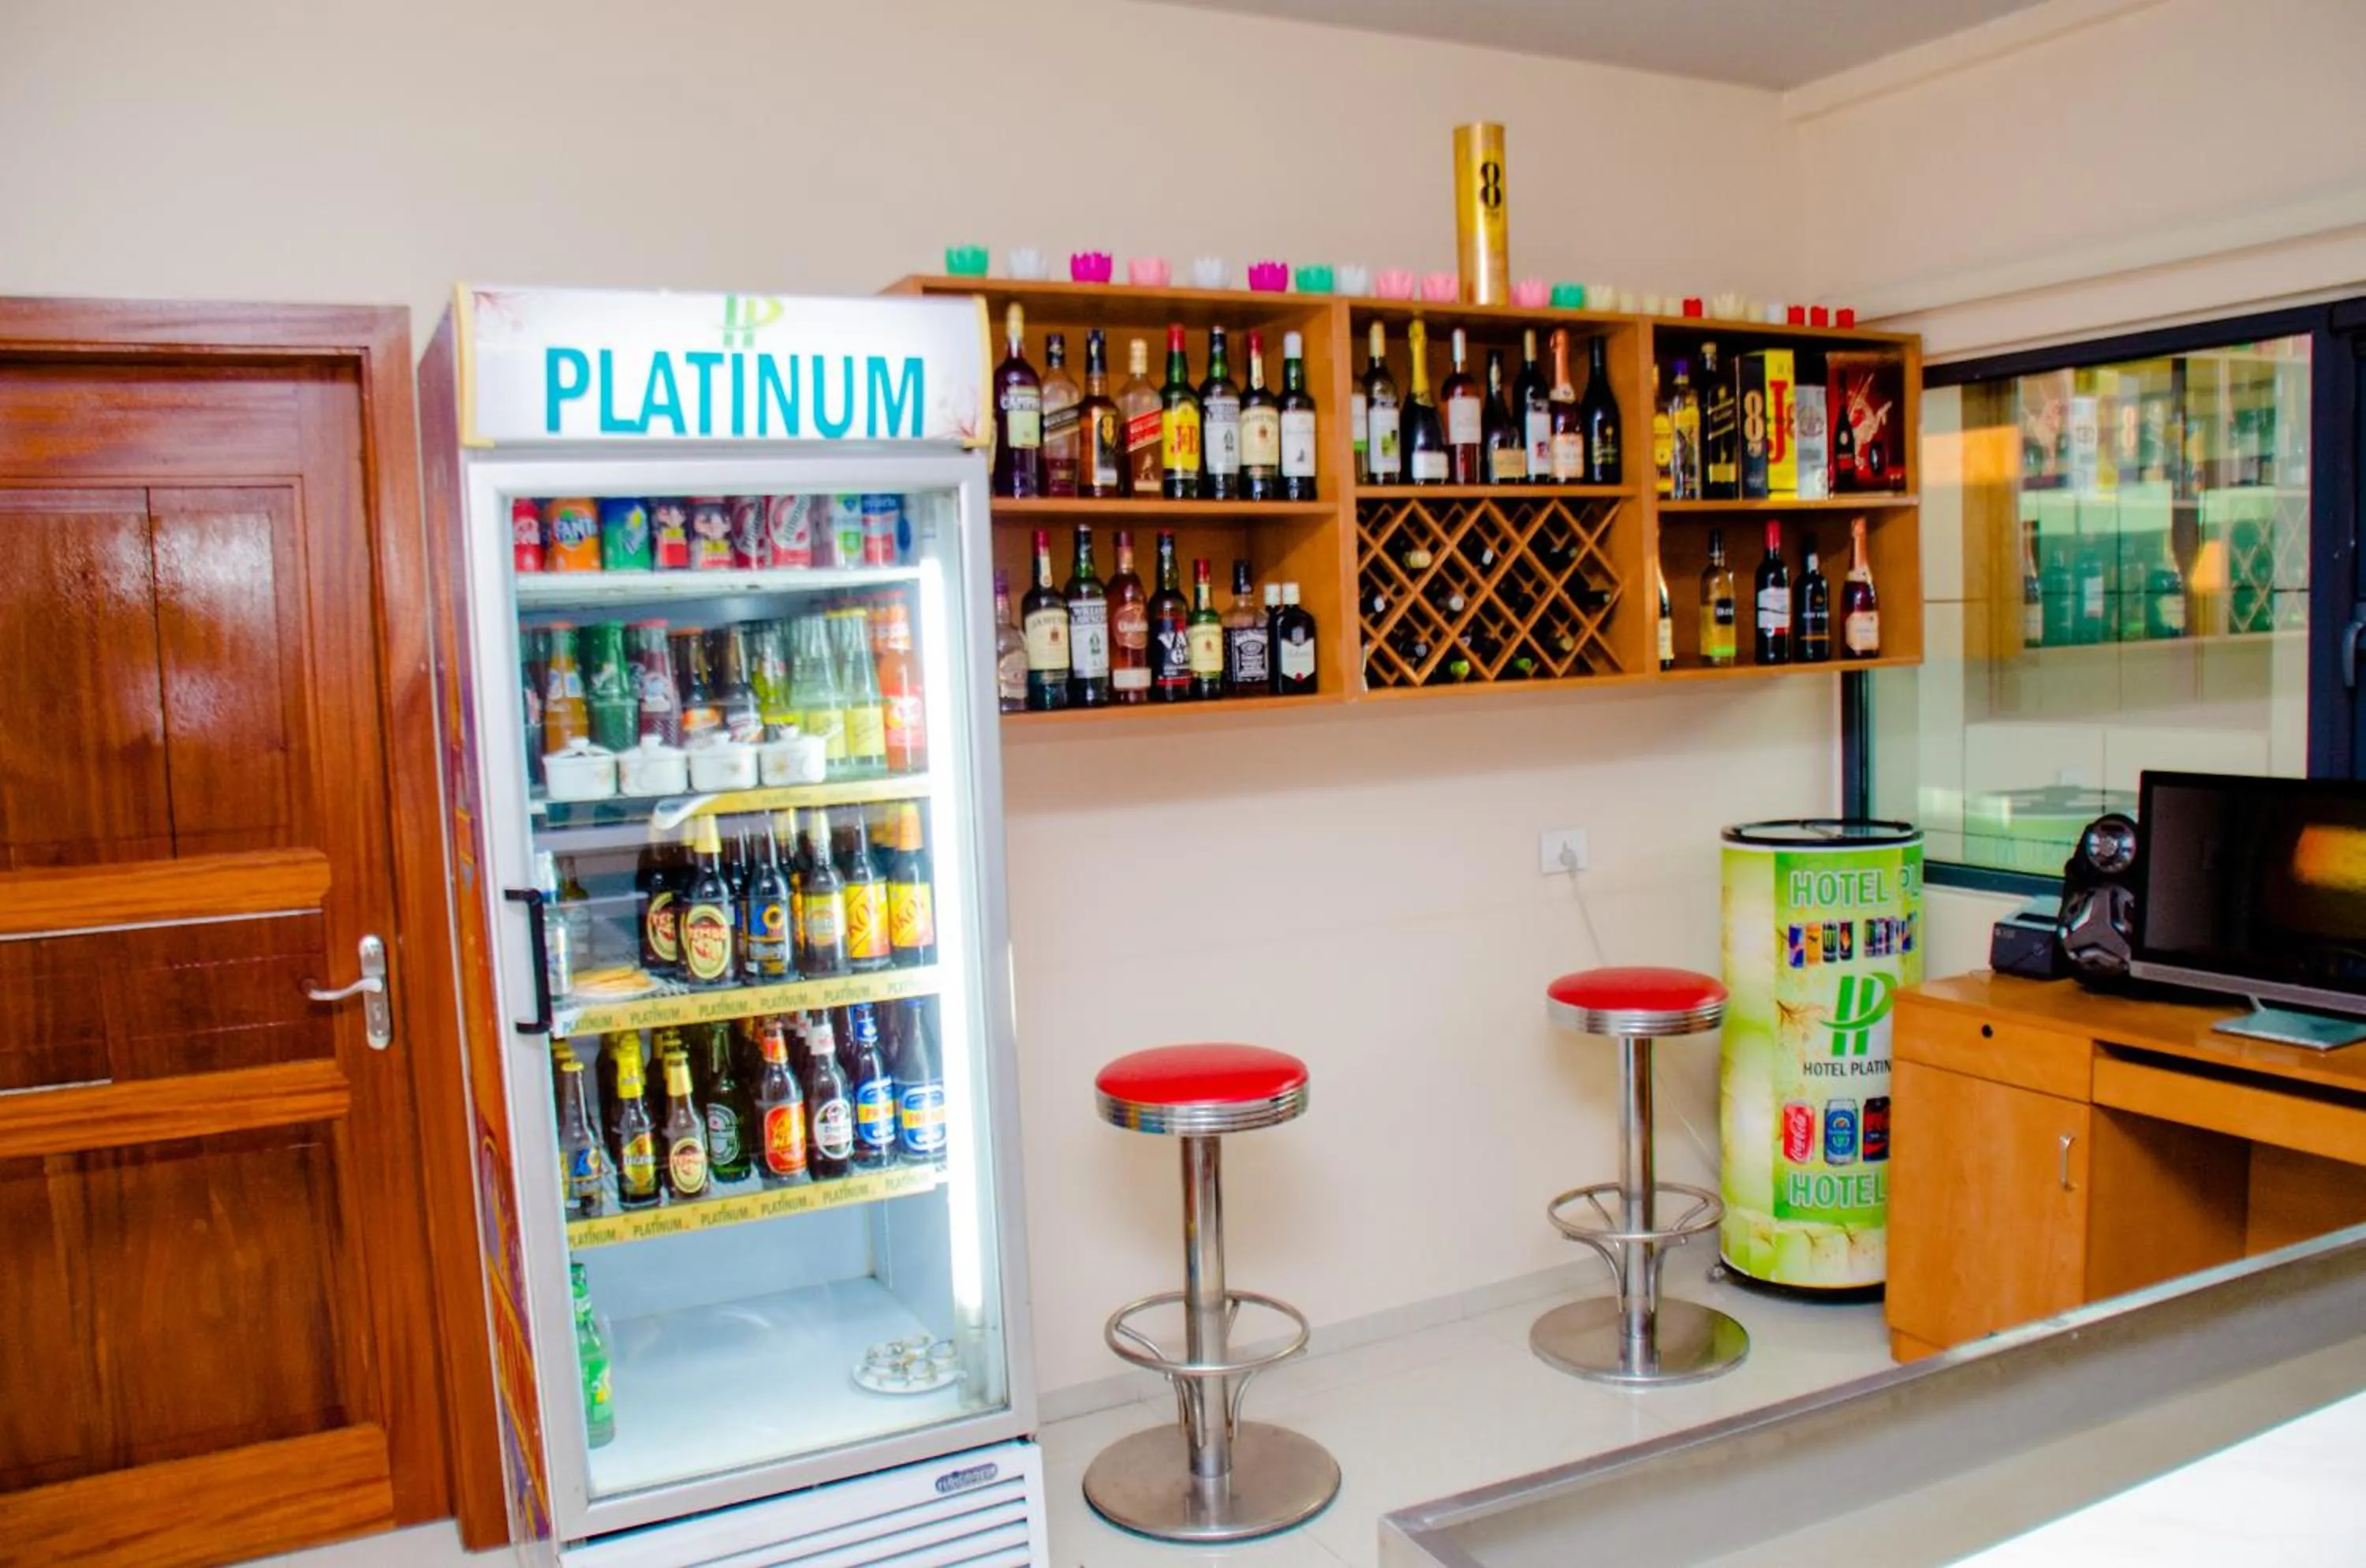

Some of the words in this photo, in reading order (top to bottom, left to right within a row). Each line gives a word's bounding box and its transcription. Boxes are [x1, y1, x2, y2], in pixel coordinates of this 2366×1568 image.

[545, 347, 924, 439] PLATINUM
[1791, 869, 1890, 906] HOTEL
[699, 1000, 748, 1017] PLATINUM
[760, 994, 807, 1010] PLATINUM
[1804, 1062, 1845, 1077] HOTEL
[1789, 1171, 1886, 1208] HOTEL
[633, 1219, 682, 1238] PLATINUM
[700, 1207, 748, 1226] PLATINUM
[759, 1196, 808, 1215] PLATINUM
